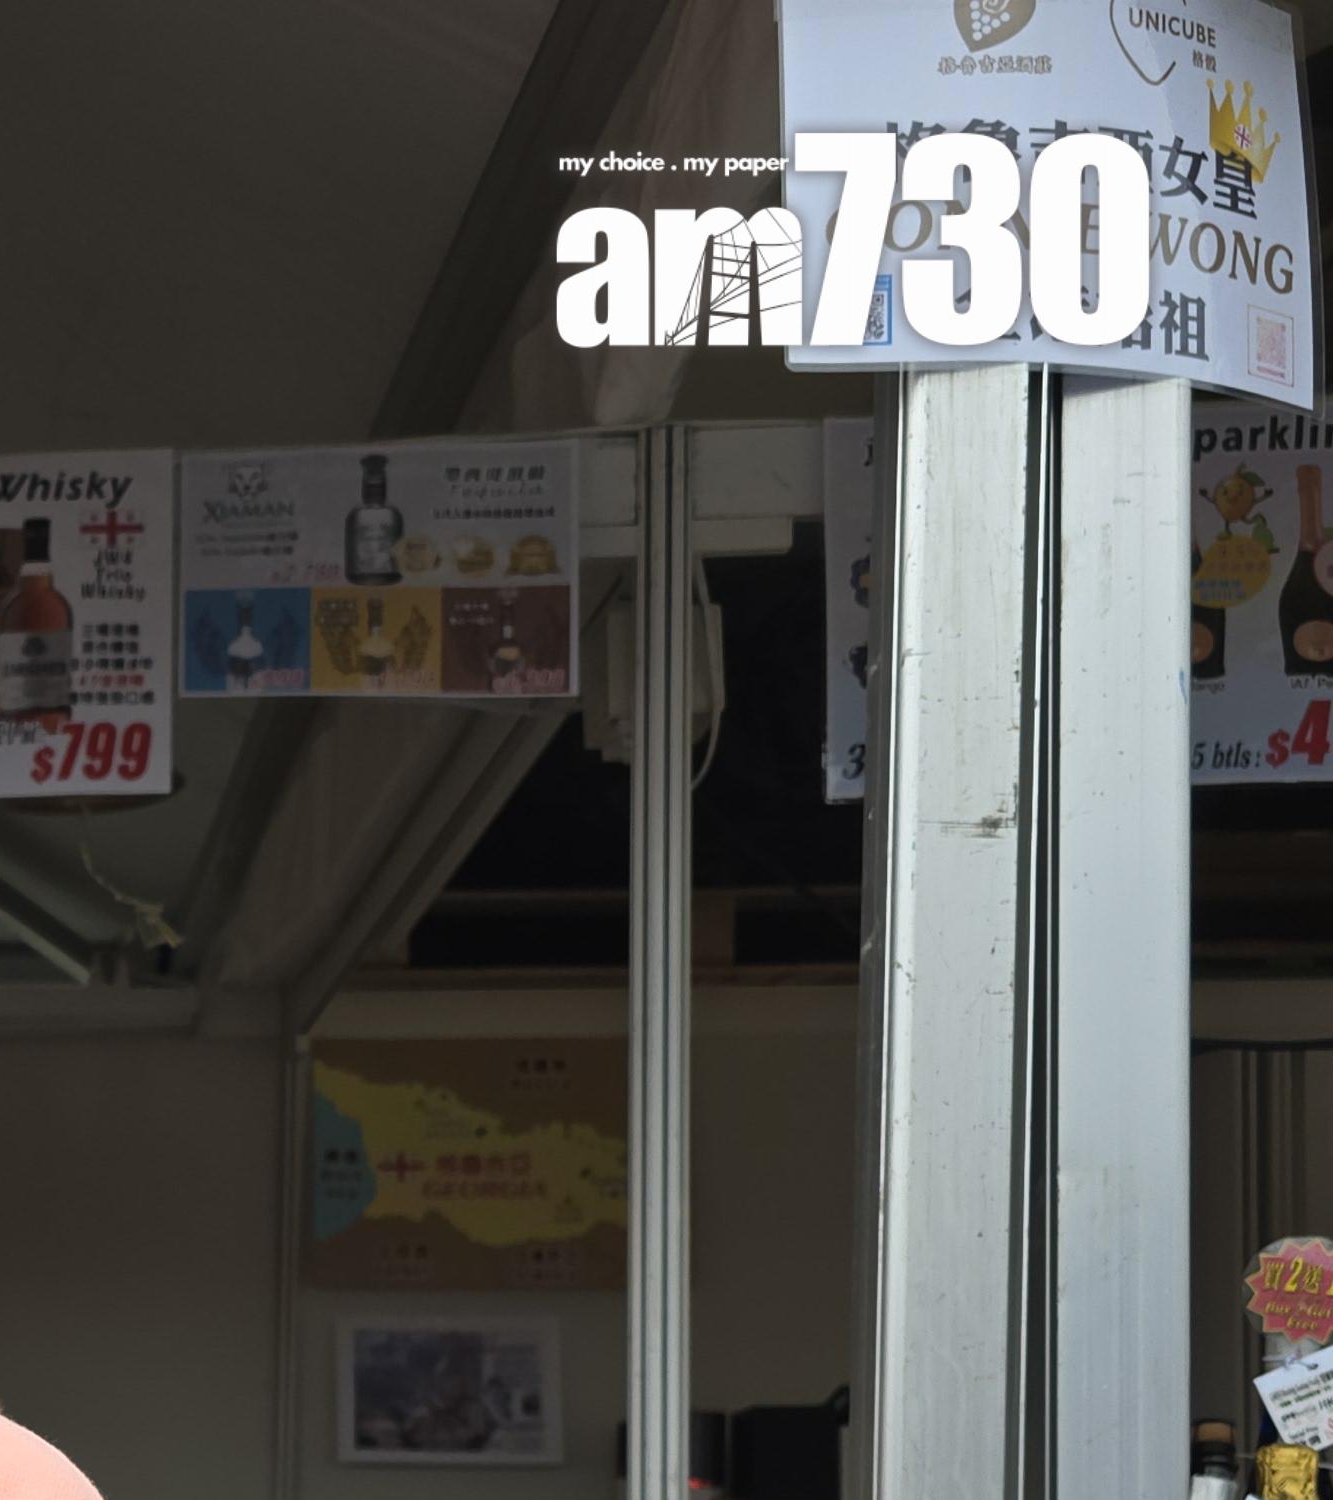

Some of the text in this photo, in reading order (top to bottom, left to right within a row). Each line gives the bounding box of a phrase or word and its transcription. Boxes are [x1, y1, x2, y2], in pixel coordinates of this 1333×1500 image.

[1129, 7, 1217, 48] UNICUBE
[1145, 210, 1294, 295] WONG
[30, 720, 153, 785] $799
